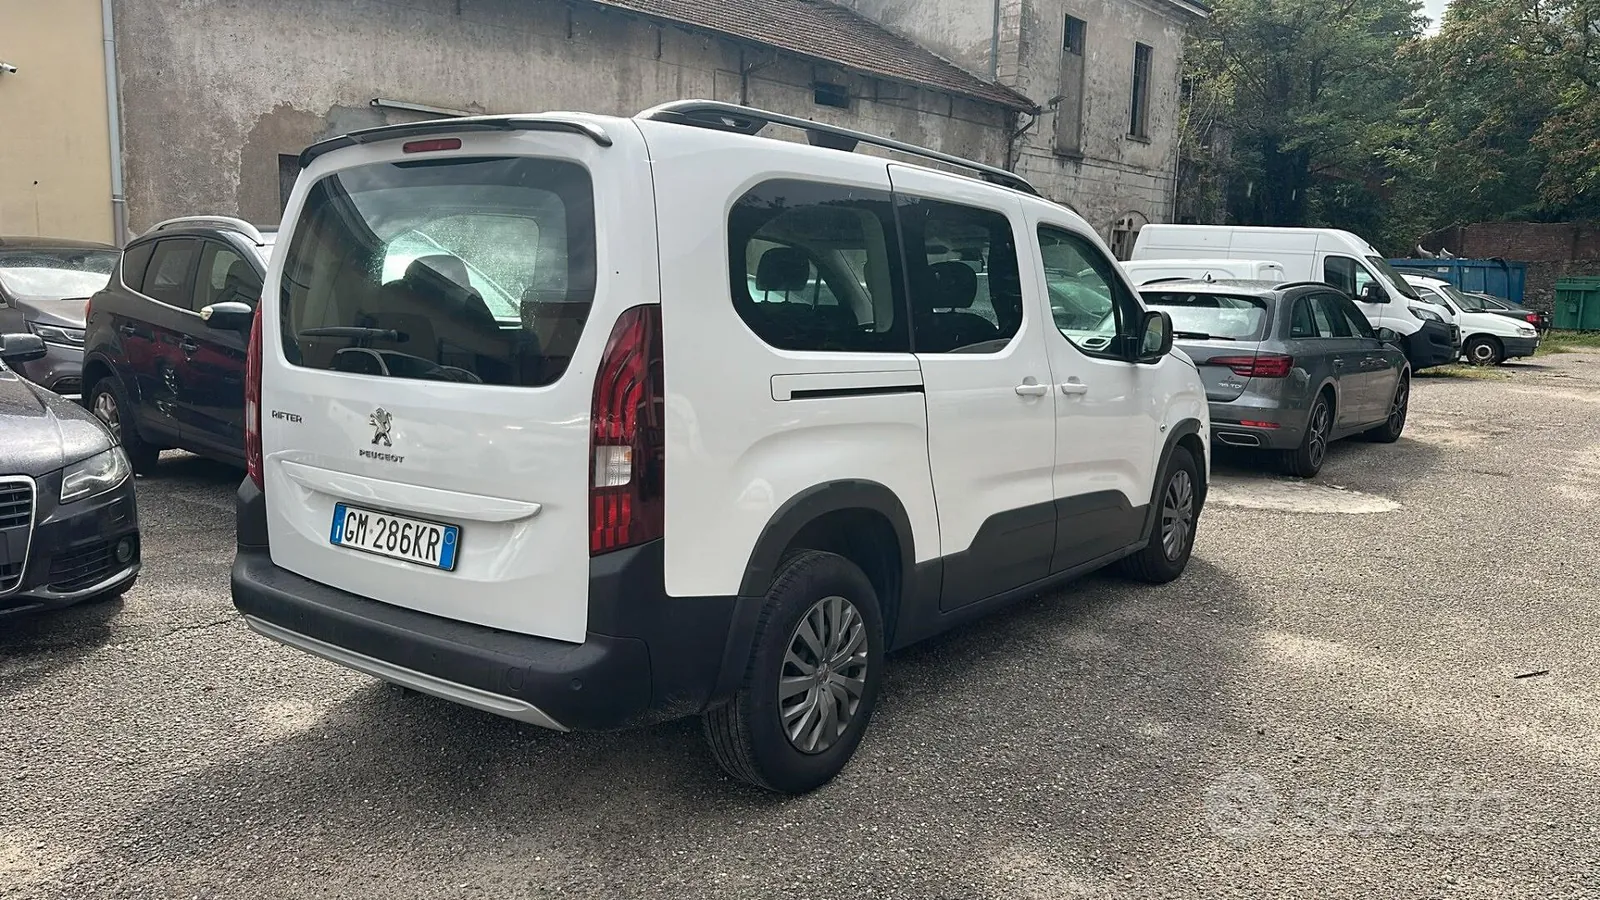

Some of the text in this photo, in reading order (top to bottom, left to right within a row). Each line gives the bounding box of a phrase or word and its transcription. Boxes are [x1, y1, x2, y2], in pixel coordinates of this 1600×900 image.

[271, 409, 303, 424] RIFTER
[359, 449, 405, 464] PEUGEOT
[344, 511, 441, 562] GM 286KR
